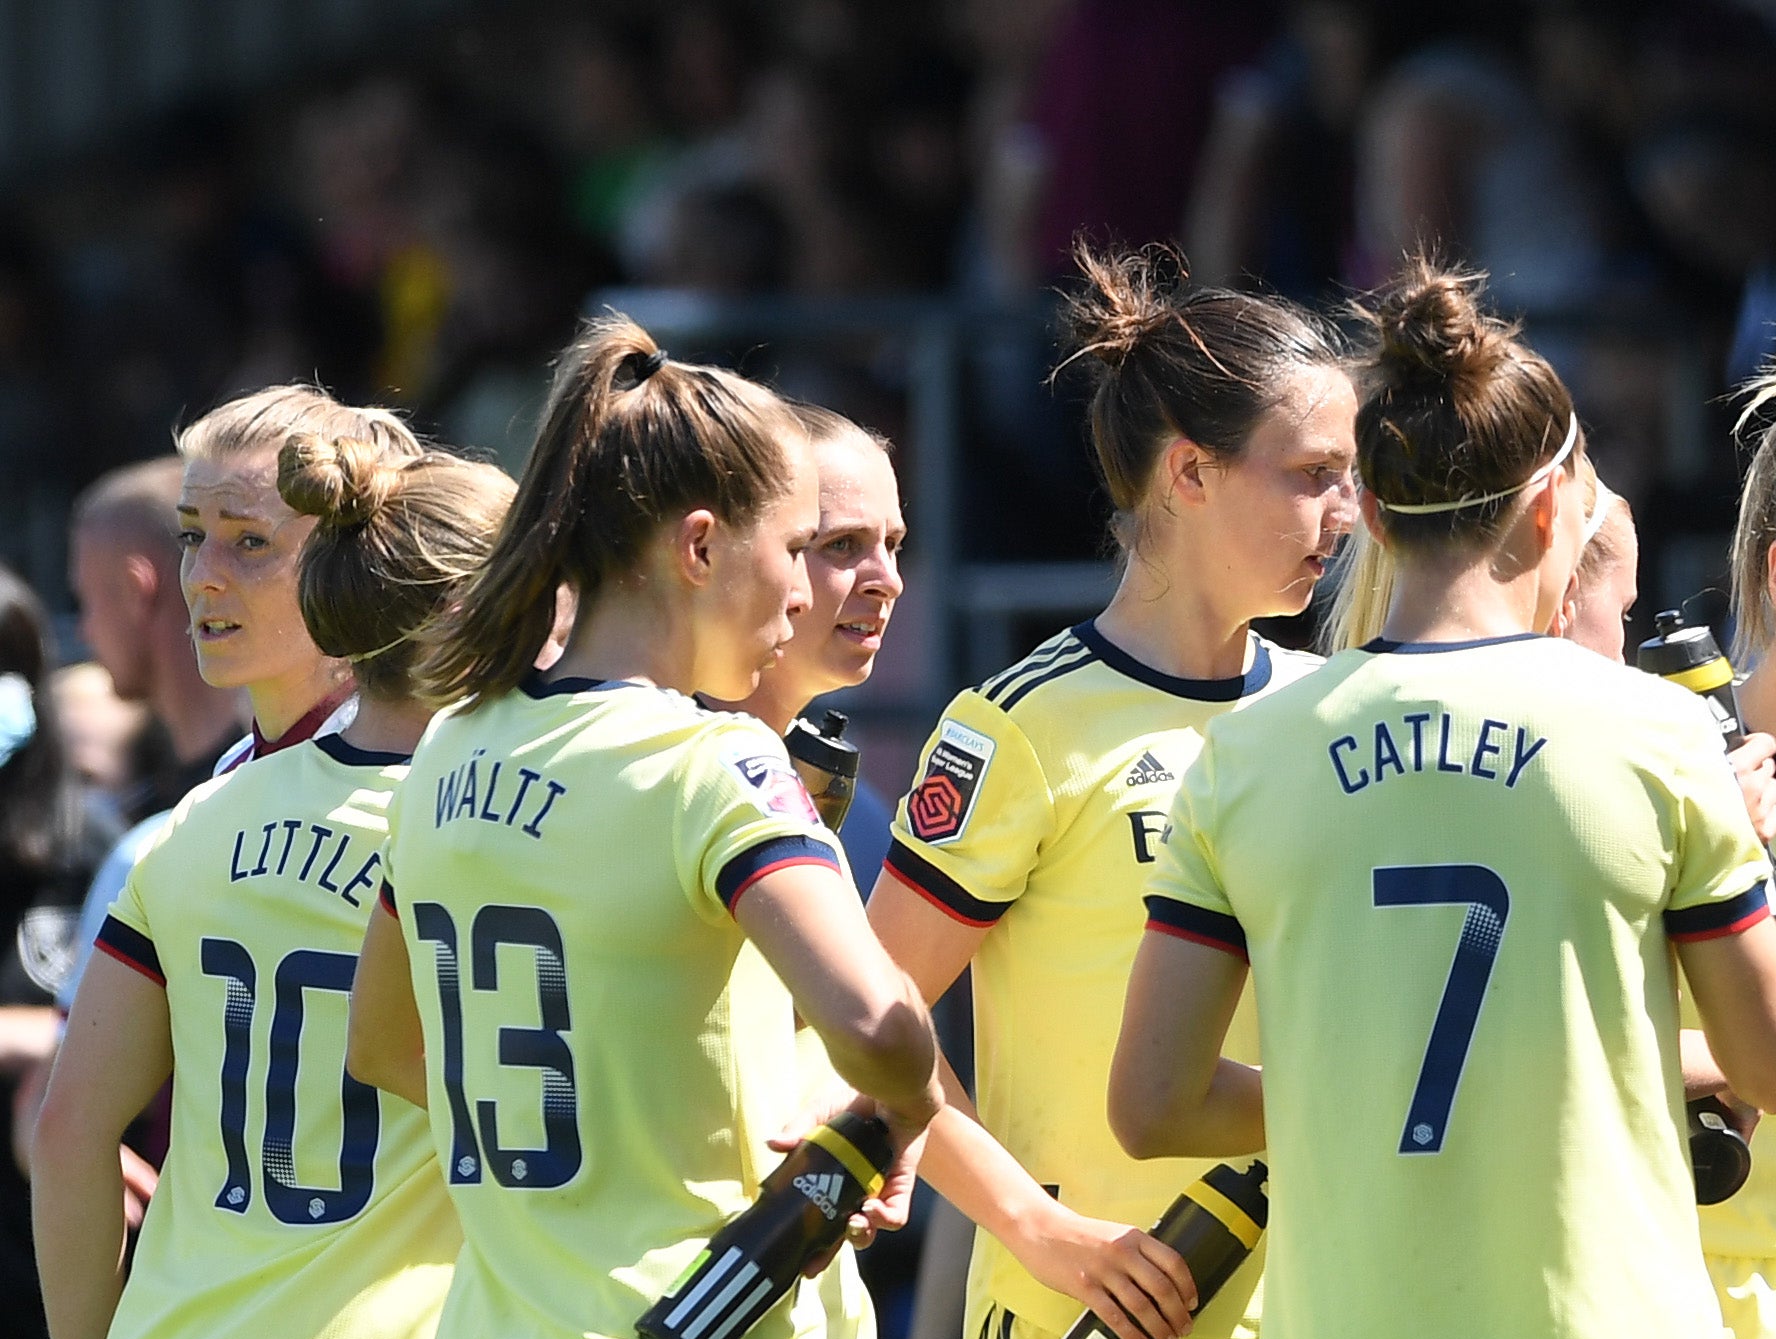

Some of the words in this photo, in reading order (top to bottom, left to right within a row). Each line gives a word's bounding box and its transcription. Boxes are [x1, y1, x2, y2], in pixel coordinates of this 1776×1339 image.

[434, 749, 567, 840] WÄLTI
[1126, 772, 1175, 787] adidas
[1329, 712, 1548, 795] CATLEY
[230, 820, 383, 909] LITTLE
[413, 902, 583, 1190] 13
[1372, 864, 1510, 1156] 7
[200, 936, 380, 1227] 10
[793, 1176, 837, 1221] adidas
